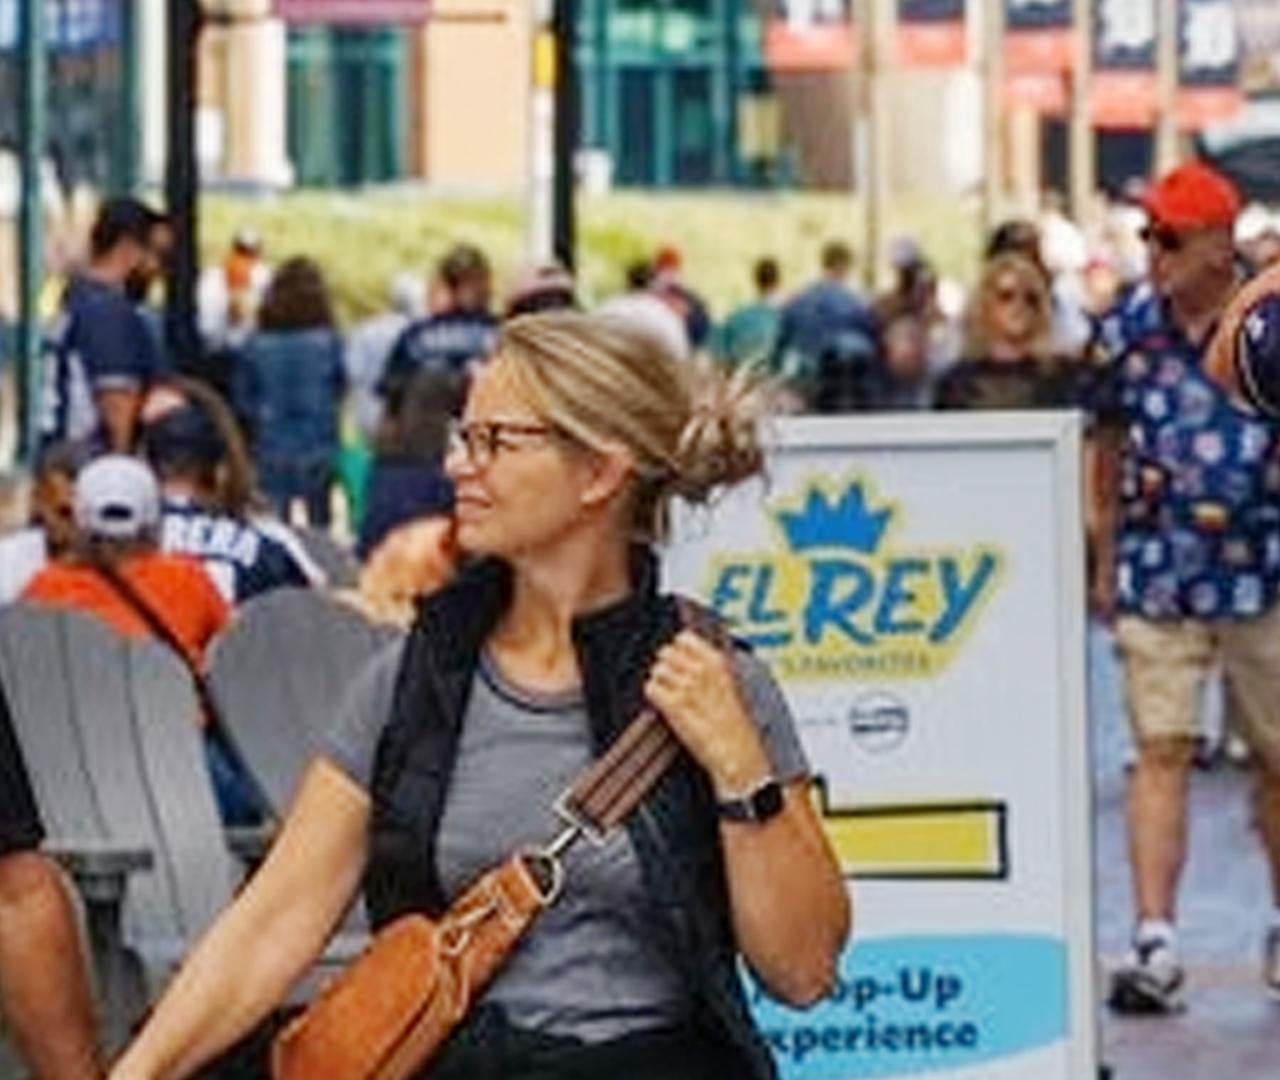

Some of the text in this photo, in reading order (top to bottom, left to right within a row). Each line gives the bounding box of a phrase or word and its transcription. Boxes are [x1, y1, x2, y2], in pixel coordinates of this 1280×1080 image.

[711, 553, 995, 646] EL REY
[765, 1014, 980, 1063] xperience
